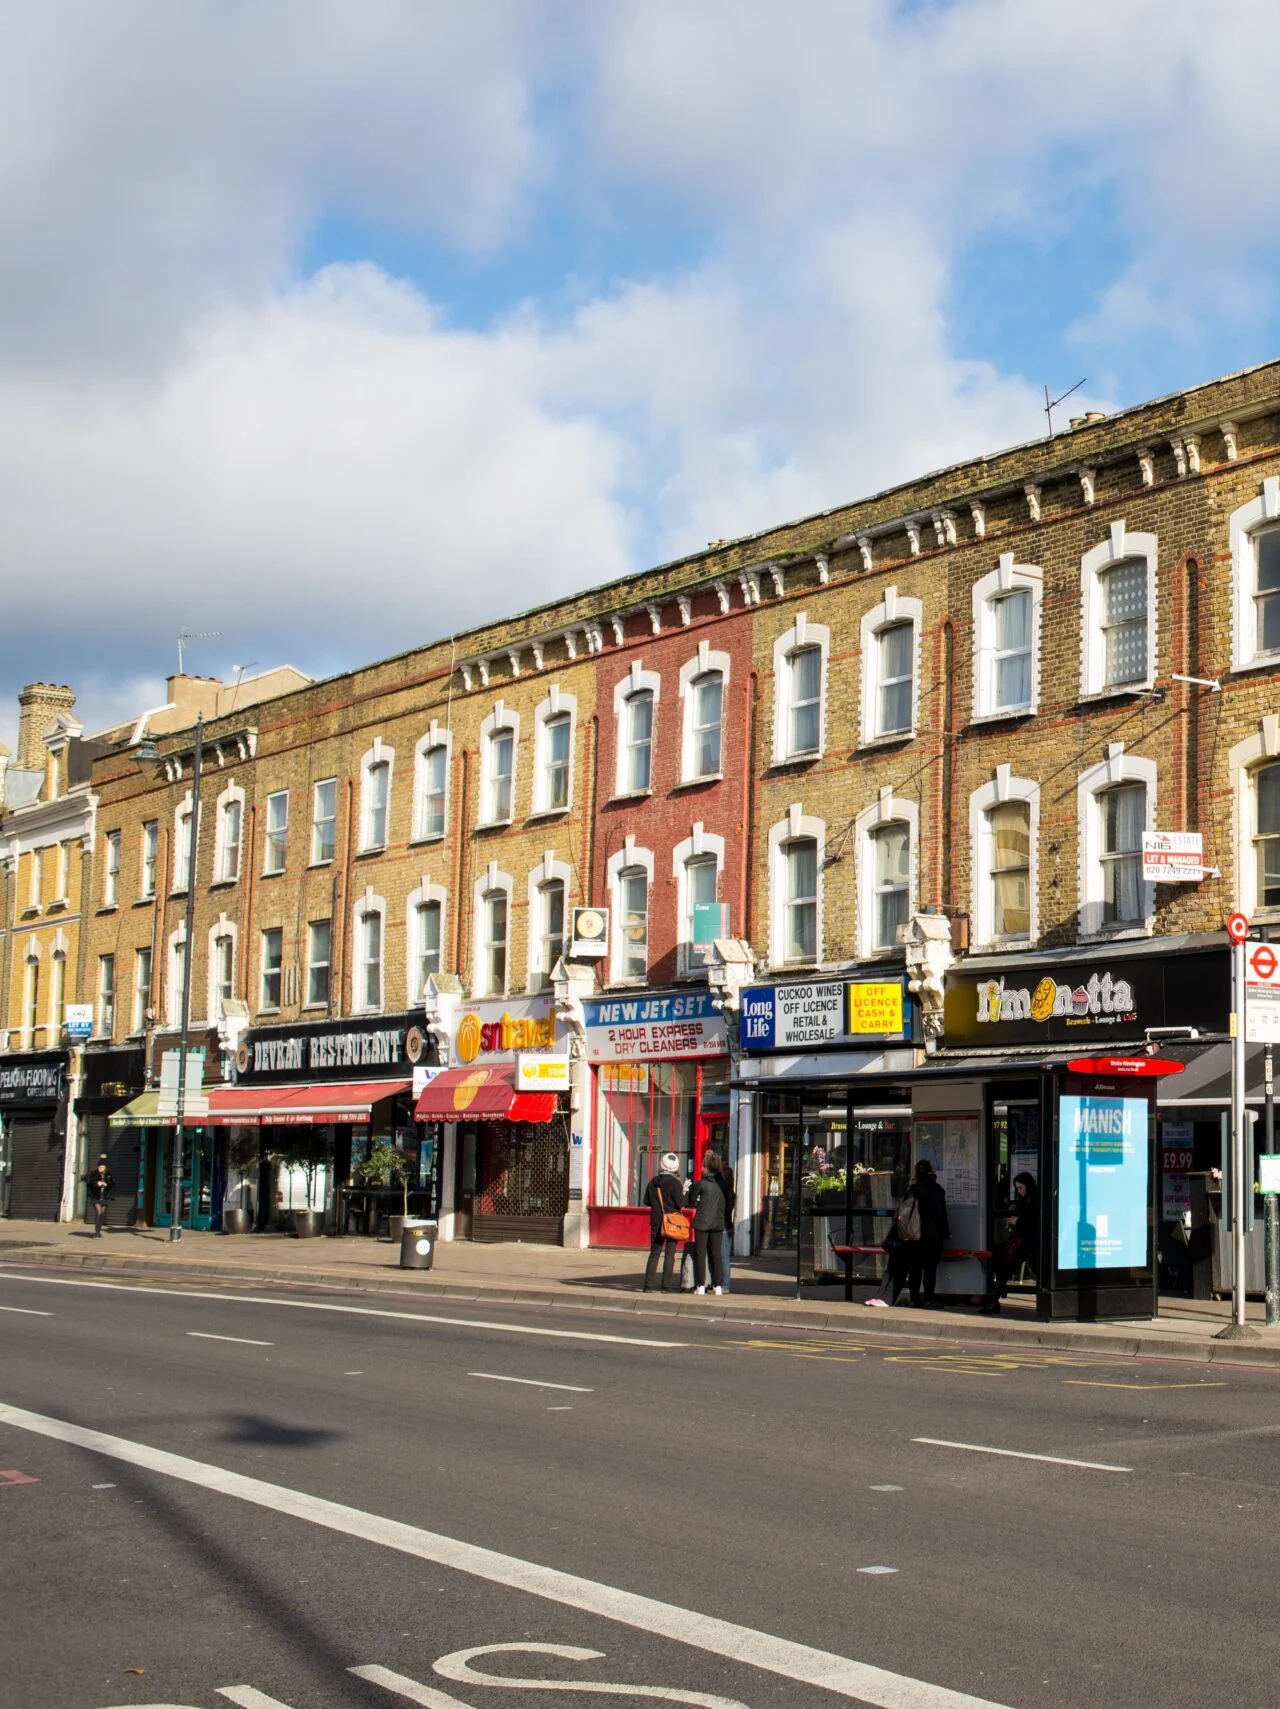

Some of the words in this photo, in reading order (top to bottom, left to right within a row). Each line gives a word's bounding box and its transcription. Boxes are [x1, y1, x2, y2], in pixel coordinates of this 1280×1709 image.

[1173, 835, 1200, 845] ESTATE
[1146, 854, 1159, 862] LET
[1160, 855, 1166, 863] &
[1167, 855, 1200, 864] MANAGED
[1146, 866, 1160, 874] 020
[1232, 917, 1246, 936] Q
[778, 987, 813, 1000] CUCKOO
[816, 984, 842, 998] WINES
[866, 988, 886, 996] OFF
[598, 1002, 638, 1024] NEW
[640, 1000, 671, 1019] JET
[673, 996, 708, 1017] SET
[743, 998, 772, 1020] Long
[784, 1002, 800, 1014] OFF
[803, 1000, 838, 1012] LICENCE
[854, 998, 898, 1008] LICENCE
[858, 1009, 886, 1018] CASH
[746, 1017, 770, 1038] Life
[793, 1015, 820, 1028] RETAIL
[822, 1016, 828, 1026] &
[861, 1020, 894, 1029] CARRY
[608, 1030, 616, 1042] 2
[619, 1028, 647, 1040] HOUR
[652, 1023, 704, 1038] EXPRESS
[785, 1028, 835, 1042] WHOLESALE
[254, 1038, 302, 1072] DEVRAN
[310, 1030, 401, 1068] RESTAURANT
[615, 1042, 636, 1055] DRY
[639, 1038, 698, 1054] CLEANERS
[26, 1068, 57, 1087] FLOORING
[858, 1120, 878, 1131] Lounge
[878, 1120, 884, 1130] &
[1074, 1107, 1132, 1134] MANISH
[1164, 1152, 1193, 1169] £9.99
